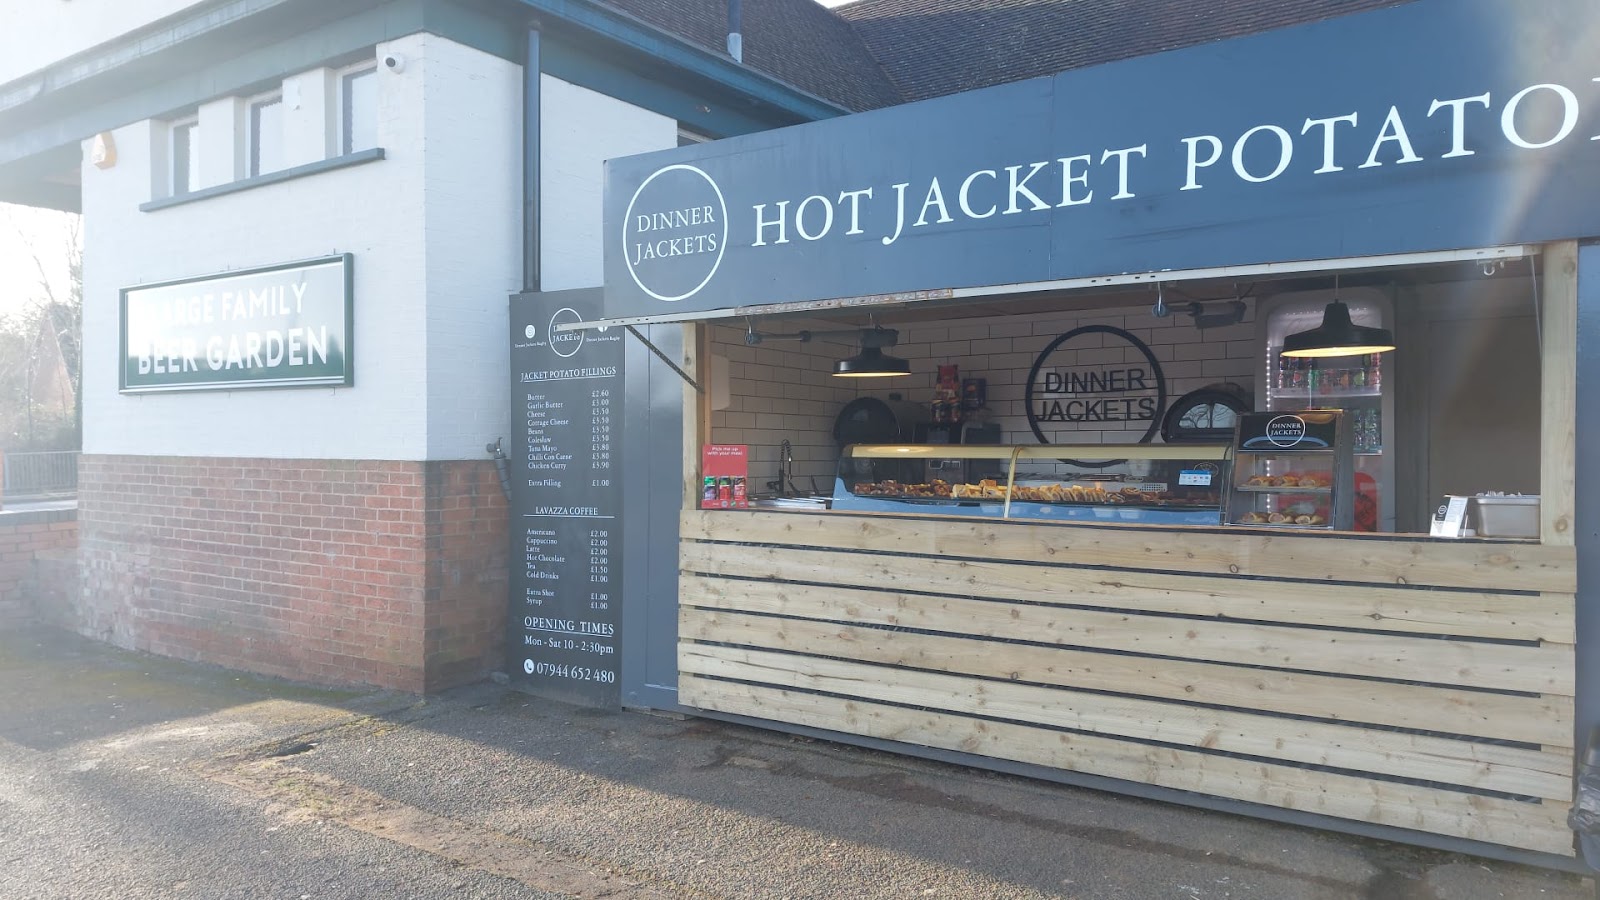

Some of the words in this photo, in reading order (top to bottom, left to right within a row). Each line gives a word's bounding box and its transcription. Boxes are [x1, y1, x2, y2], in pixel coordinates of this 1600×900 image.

[751, 186, 874, 248] HOT
[881, 143, 1147, 246] JACKET
[636, 205, 716, 233] DINNER
[633, 233, 717, 266] JACKETS
[221, 281, 307, 322] FAMILY
[138, 334, 199, 375] BEER
[206, 324, 328, 371] GARDEN
[519, 371, 548, 382] JACKET
[549, 368, 580, 379] POTATO
[581, 366, 617, 376] FILLINGS
[1044, 368, 1148, 393] DINNER
[1034, 397, 1157, 422] JACKETS
[1270, 429, 1302, 437] JACKETS
[535, 506, 568, 515] LAVAZZA
[569, 507, 599, 516] COFFEE
[524, 615, 575, 631] OPENING
[580, 621, 614, 635] TIMES
[525, 635, 542, 646] Mon
[548, 637, 561, 648] Sat
[563, 639, 574, 650] 10
[581, 640, 614, 656] 2:30pm
[536, 662, 569, 678] 07944
[570, 665, 591, 681] 652
[592, 668, 615, 684] 480
